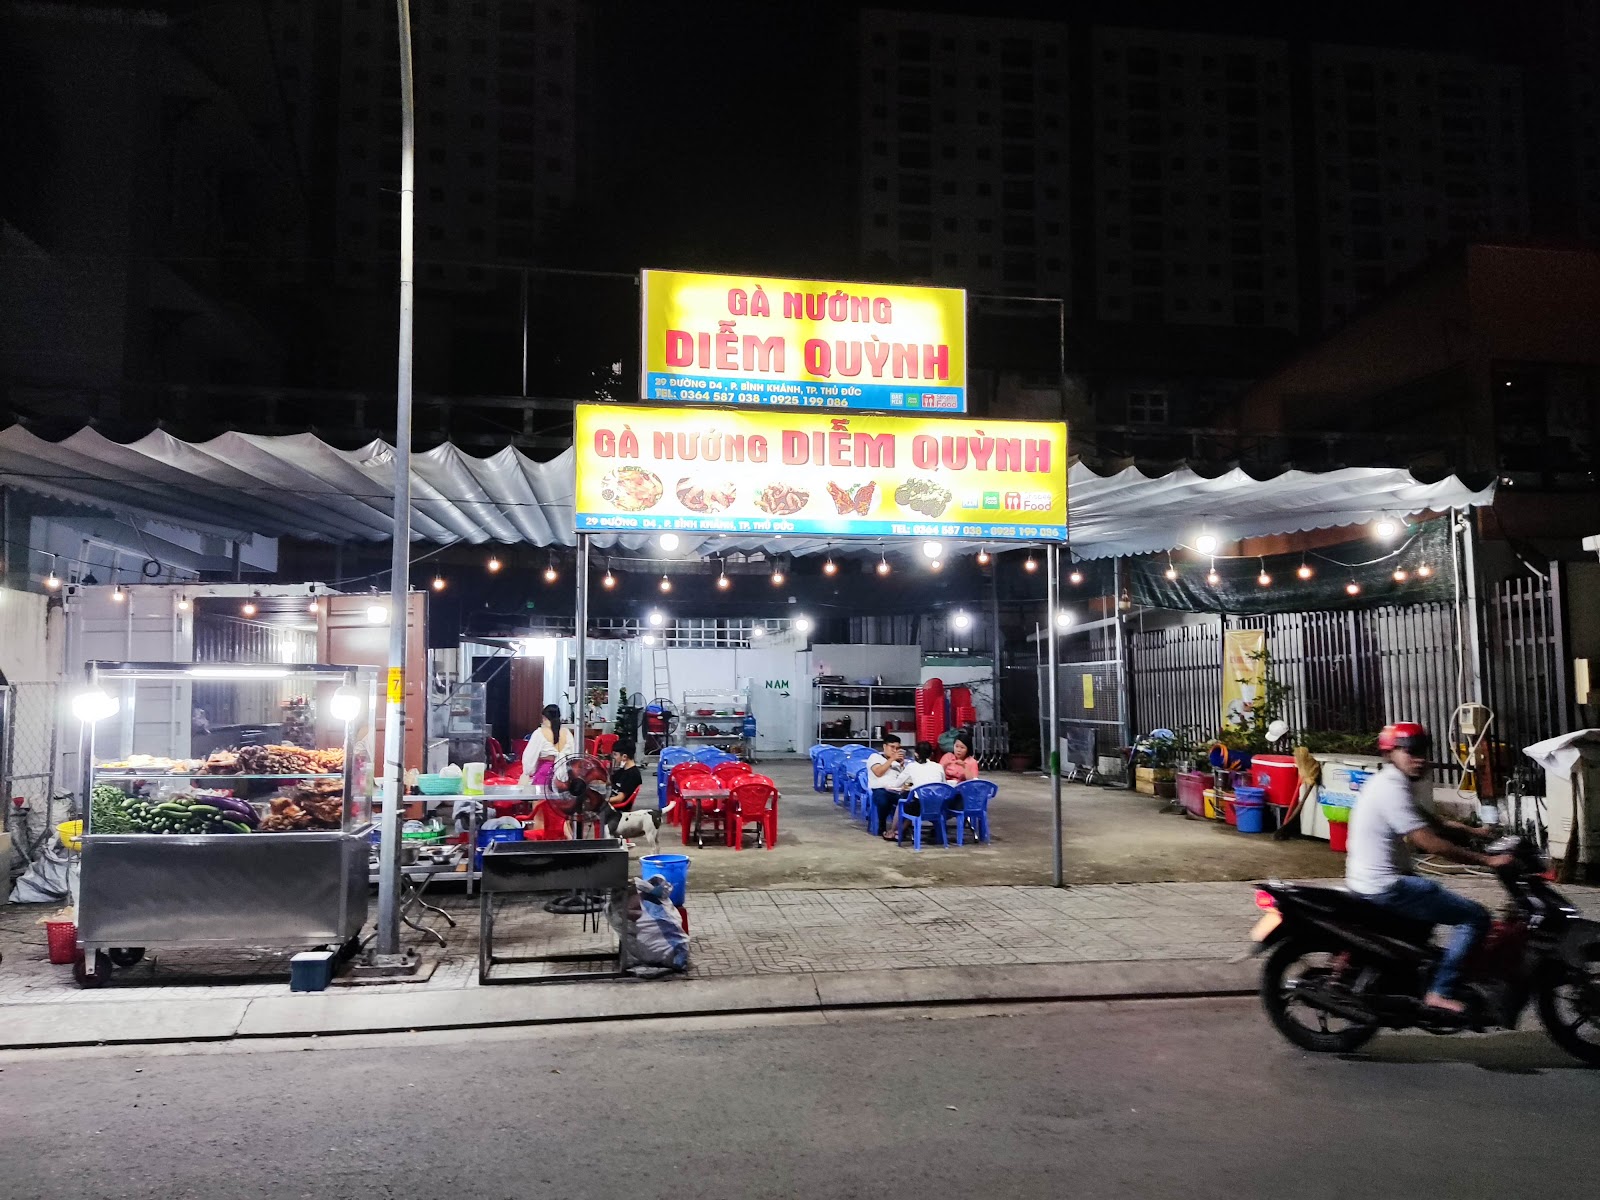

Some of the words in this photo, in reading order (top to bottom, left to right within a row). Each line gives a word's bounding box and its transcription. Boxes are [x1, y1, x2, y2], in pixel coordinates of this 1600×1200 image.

[728, 284, 770, 317] GÀ
[783, 290, 892, 324] NƯỚNG
[665, 320, 785, 373] DIỄM
[804, 334, 949, 380] QUỲNH
[655, 377, 667, 386] 29
[670, 377, 706, 389] ĐƯỜNG
[741, 380, 764, 391] BÌNH
[767, 382, 803, 395] KHÁNH,
[806, 386, 817, 394] TP.
[820, 385, 838, 396] THỦ
[841, 386, 862, 396] ĐỨC
[655, 388, 677, 398] TEL:
[680, 390, 710, 400] 0364
[713, 392, 735, 401] 587
[738, 393, 760, 402] 038
[770, 395, 799, 405] 0925
[803, 395, 824, 406] 199
[827, 396, 848, 407] 086
[936, 400, 957, 408] Food
[594, 424, 639, 458] GÀ
[653, 428, 768, 463] NƯỚNG
[782, 418, 895, 468] DIỄM
[912, 429, 1051, 473] QUỲNH
[1024, 500, 1051, 510] Food
[586, 517, 598, 525] 29
[600, 516, 638, 527] ĐƯỜNG
[674, 518, 697, 528] BÌNH
[754, 519, 771, 530] THỦ
[765, 679, 789, 689] NAM
